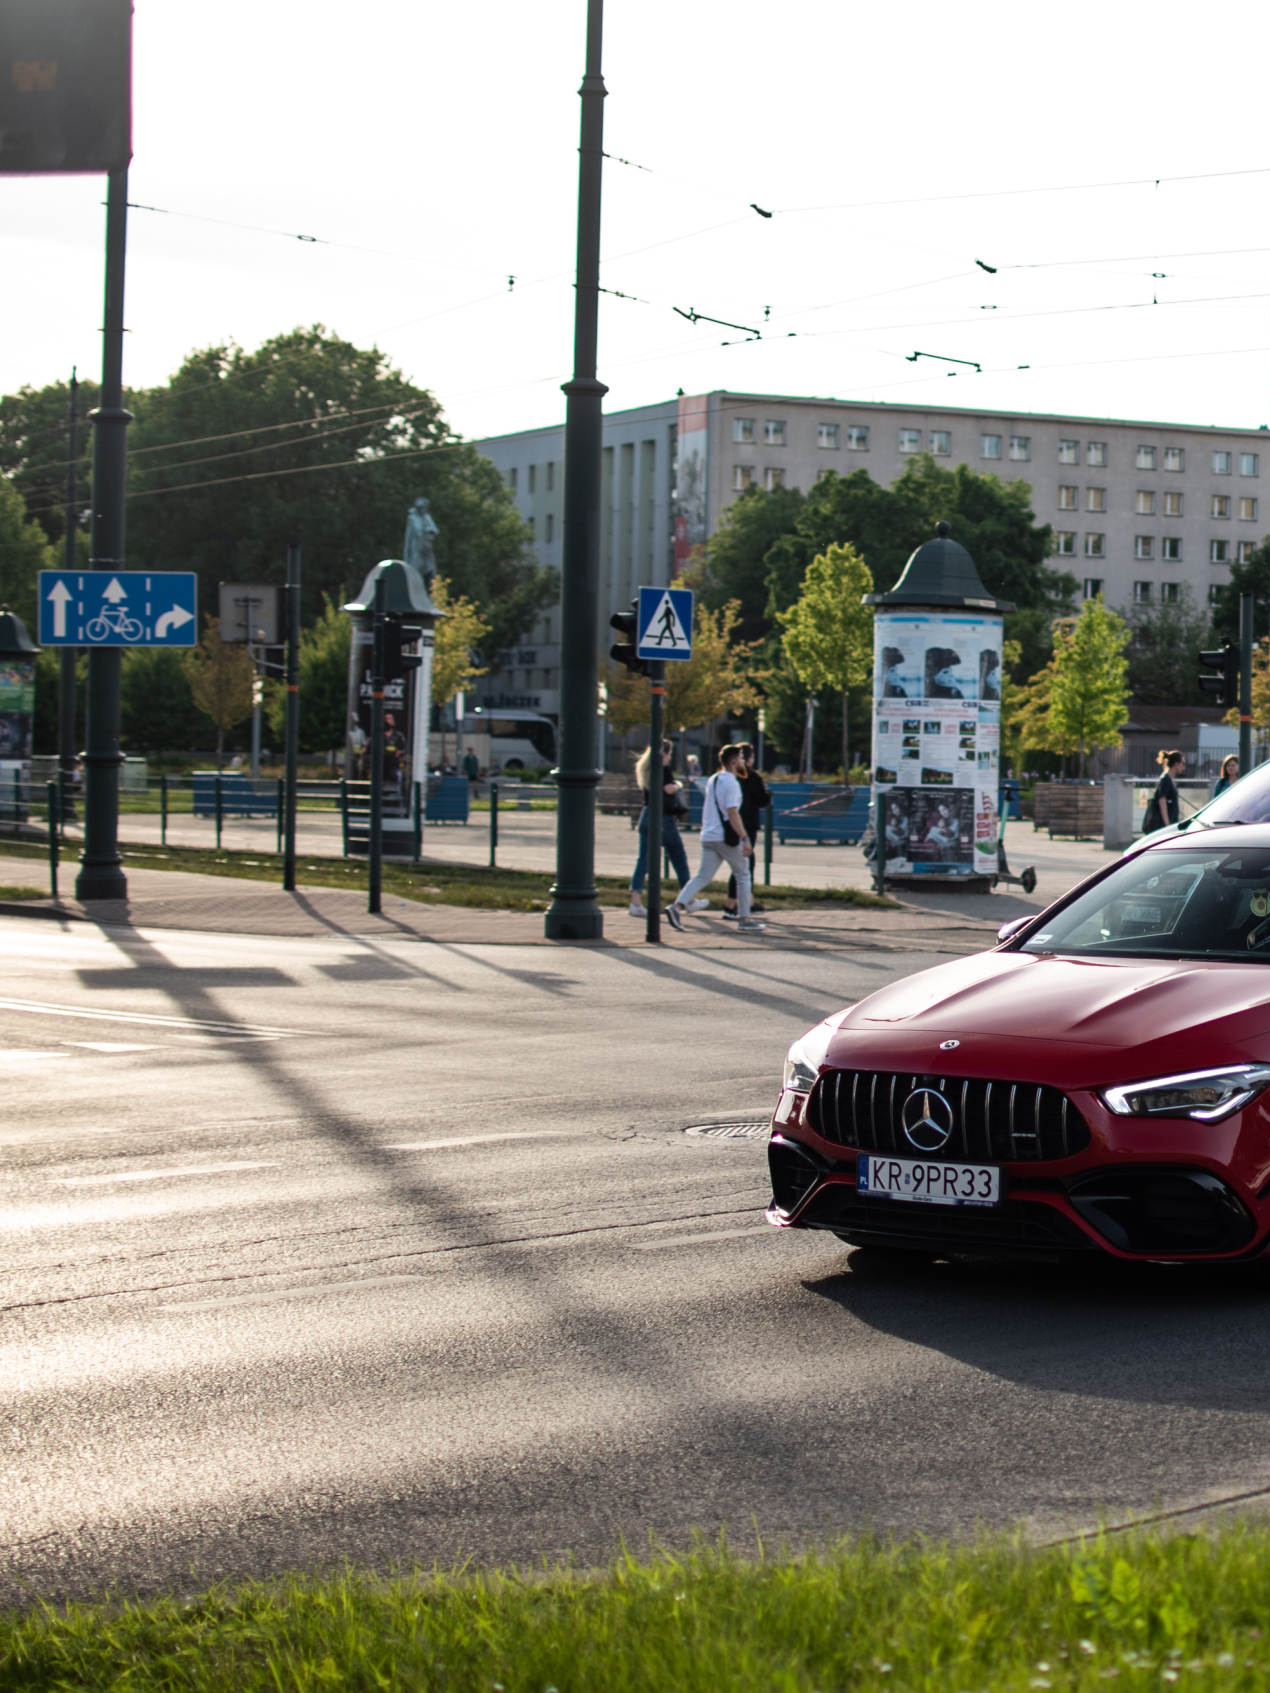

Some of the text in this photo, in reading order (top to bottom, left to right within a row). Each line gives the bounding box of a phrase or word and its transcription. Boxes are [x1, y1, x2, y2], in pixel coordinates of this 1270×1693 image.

[860, 1176, 868, 1185] PL
[873, 1160, 993, 1198] KR 9PR33
